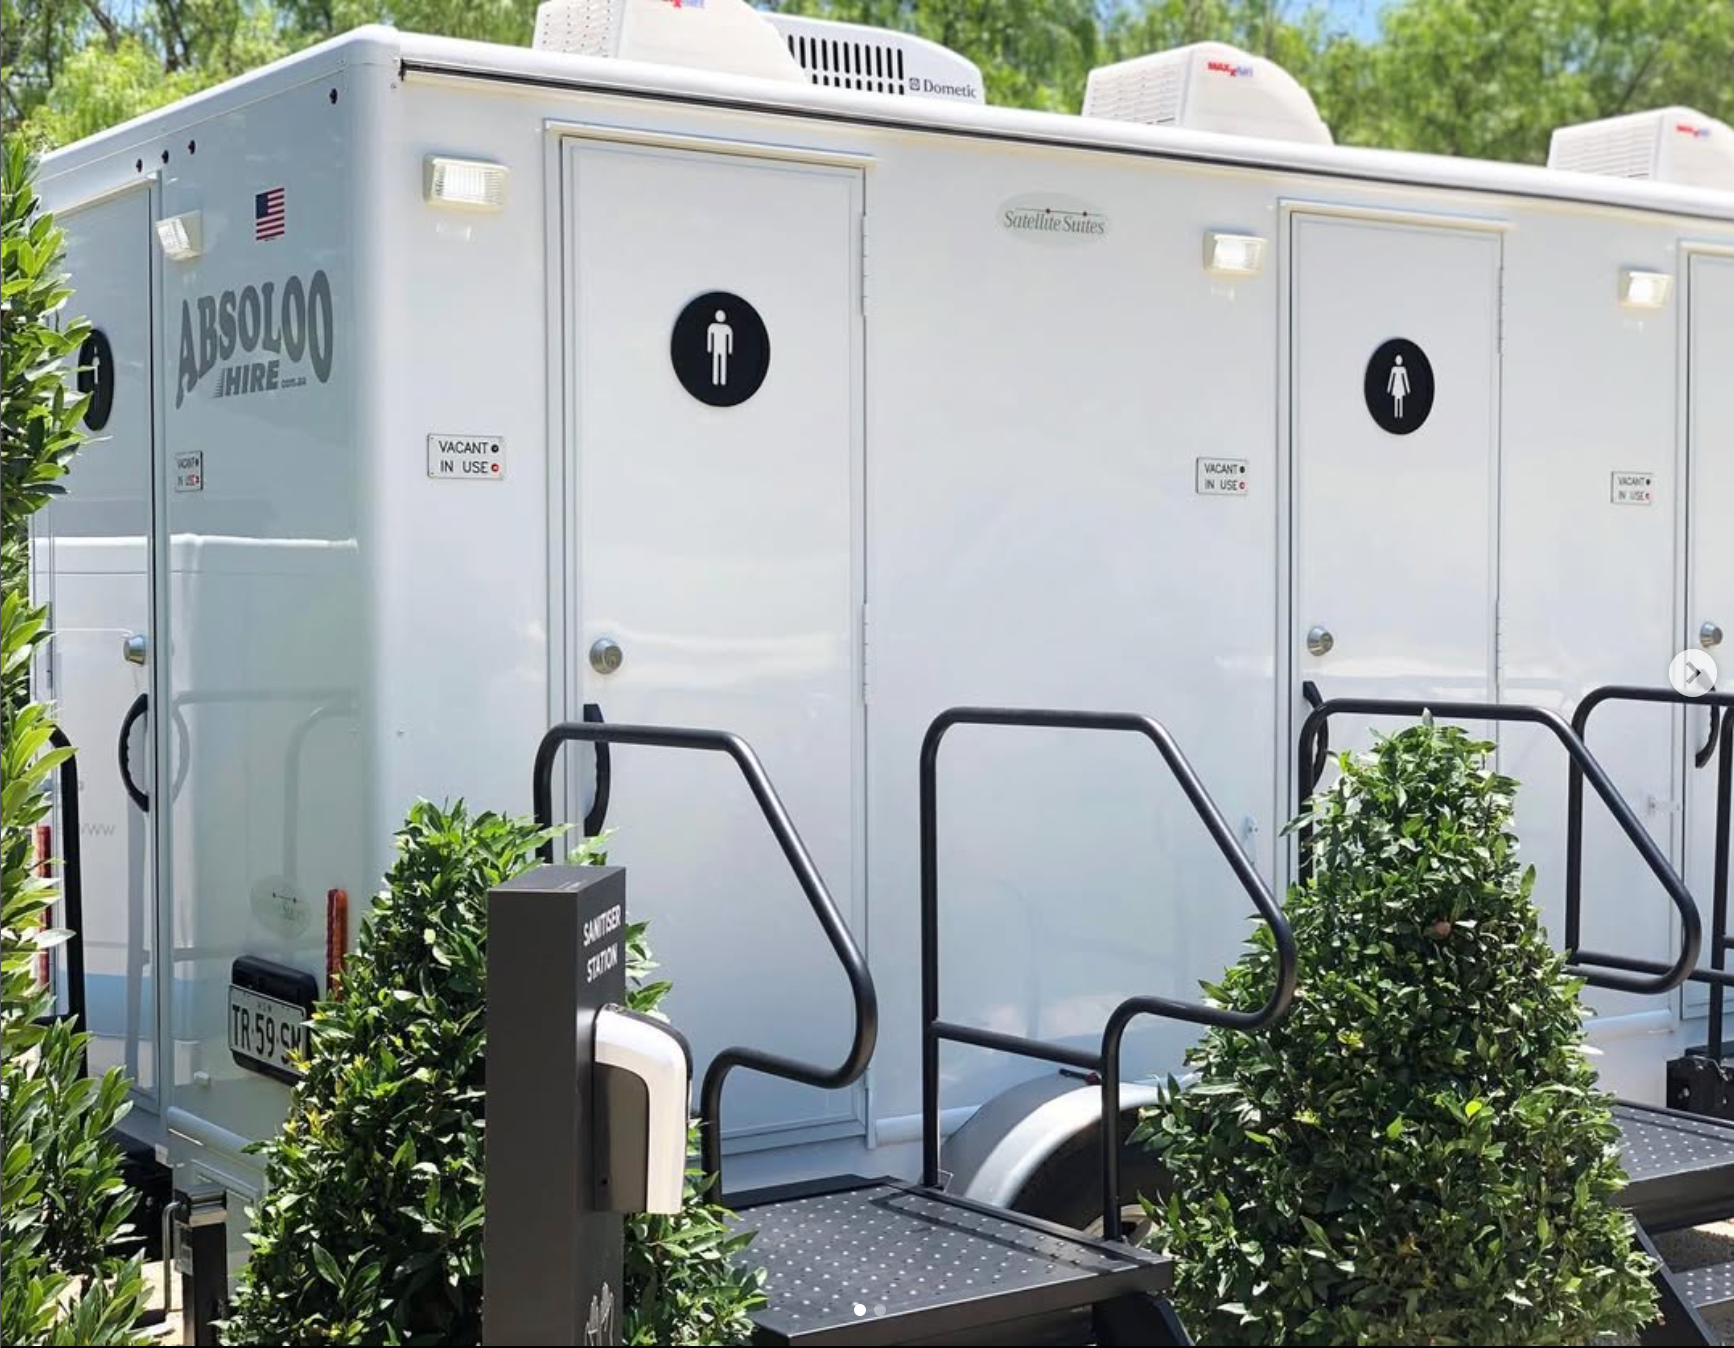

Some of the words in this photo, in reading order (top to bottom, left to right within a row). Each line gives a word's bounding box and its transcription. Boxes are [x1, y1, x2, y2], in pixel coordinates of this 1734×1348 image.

[923, 79, 977, 99] Dometic
[1003, 210, 1061, 232] Satellite
[1061, 215, 1106, 235] Suites
[176, 269, 333, 410] ABSOLOO
[224, 360, 280, 397] HIRE
[438, 440, 489, 454] VACANT
[440, 460, 454, 473] IN
[462, 461, 489, 474] USE
[1204, 462, 1238, 475] VACANT
[1204, 479, 1215, 490] IN
[1220, 479, 1238, 491] USE
[583, 904, 621, 947] SANITISER
[587, 942, 618, 984] STATION
